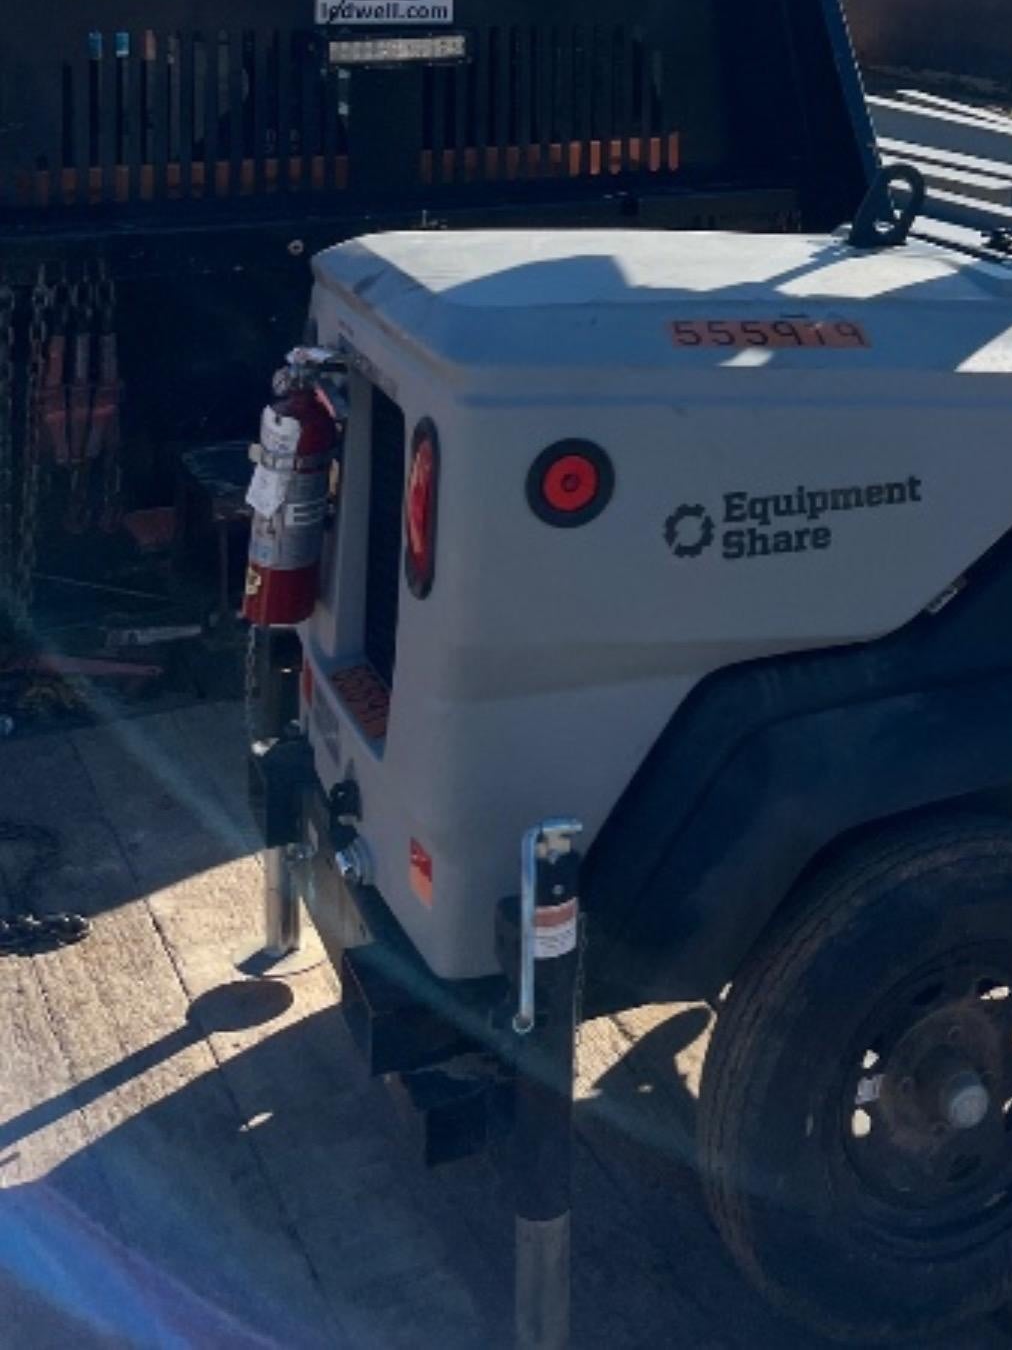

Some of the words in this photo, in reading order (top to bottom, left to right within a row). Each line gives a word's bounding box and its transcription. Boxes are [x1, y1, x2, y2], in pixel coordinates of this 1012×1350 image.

[321, 3, 448, 20] ledwell.com
[671, 319, 866, 347] 555979
[722, 475, 922, 526] Equipment
[722, 526, 832, 560] Share
